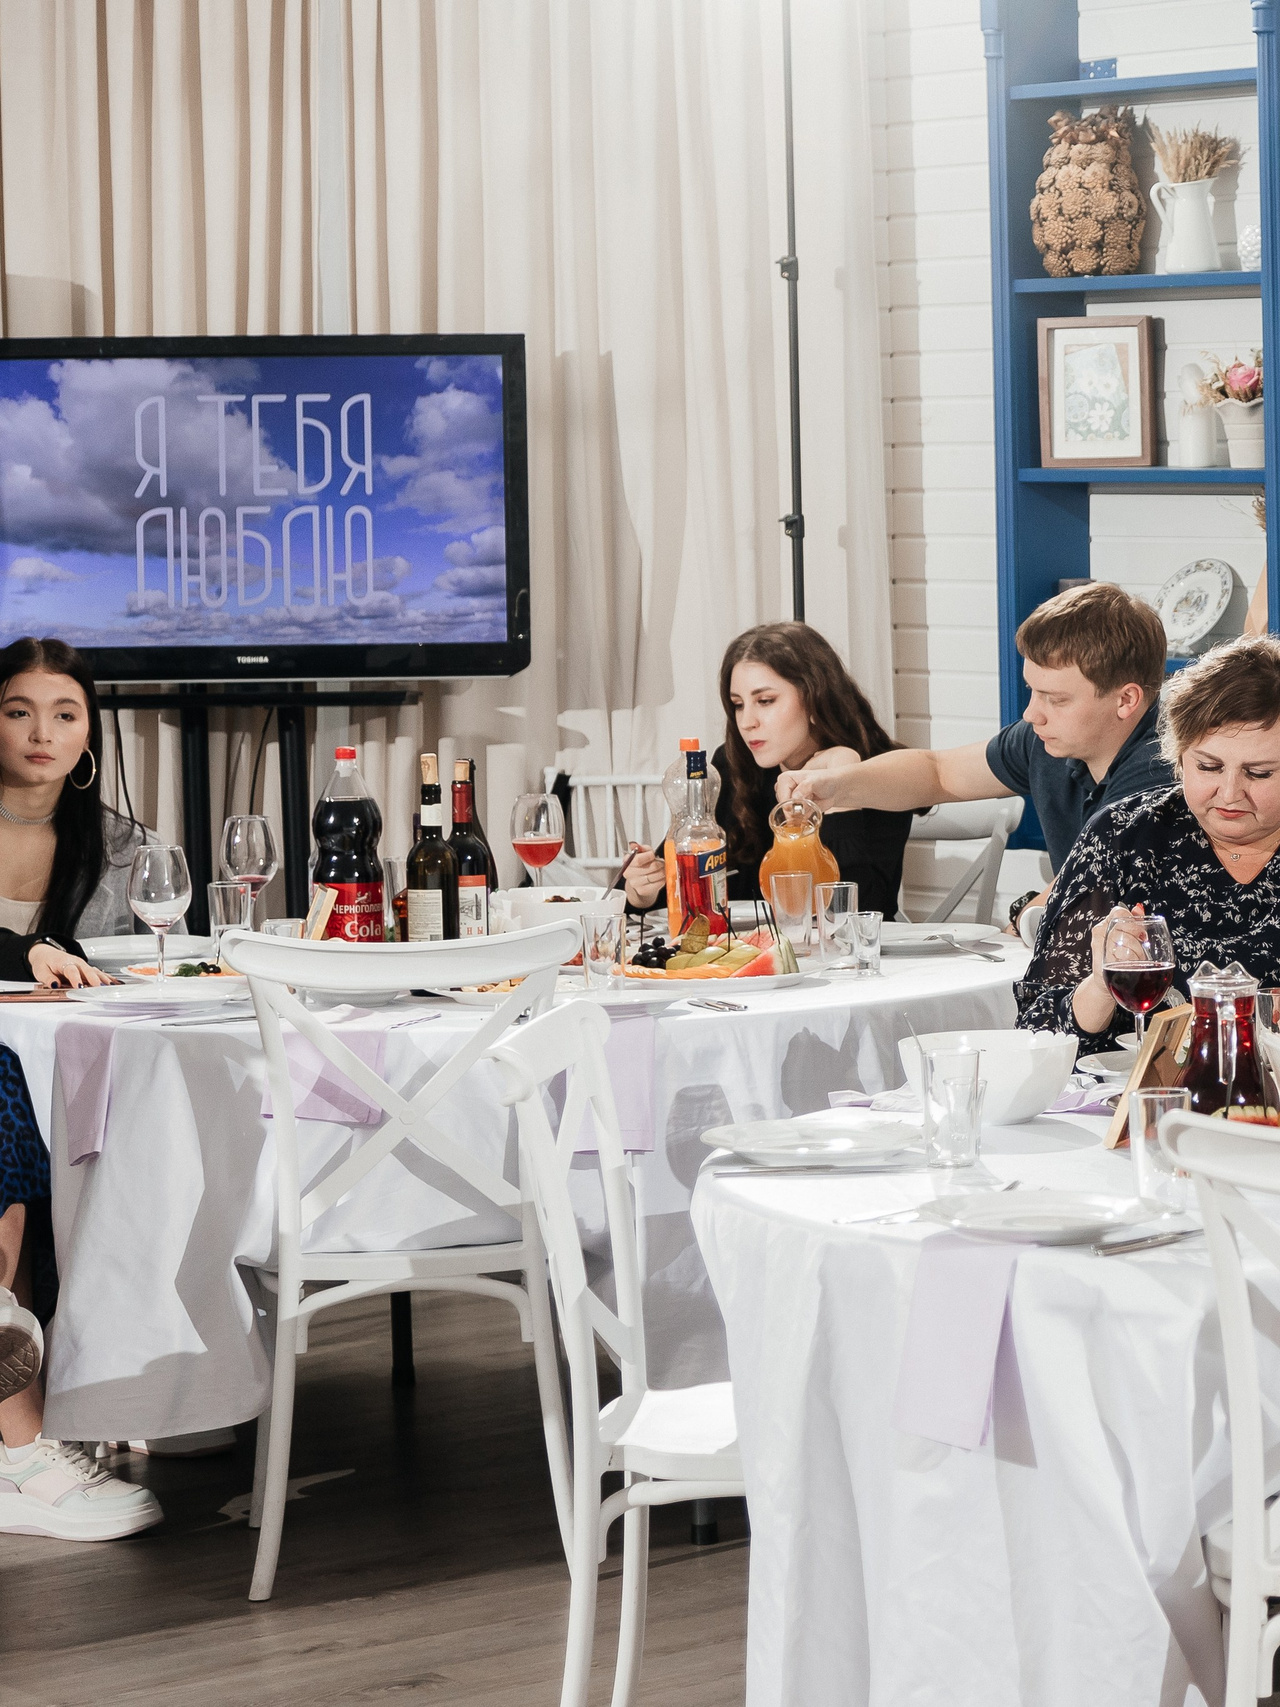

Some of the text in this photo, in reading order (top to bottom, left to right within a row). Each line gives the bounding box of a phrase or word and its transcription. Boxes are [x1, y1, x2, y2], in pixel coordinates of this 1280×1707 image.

[134, 393, 373, 498] Я ТЕБЯ
[135, 504, 374, 609] ЛЮБЛЮ
[236, 655, 270, 664] TOSHIBA
[345, 920, 381, 938] Cola
